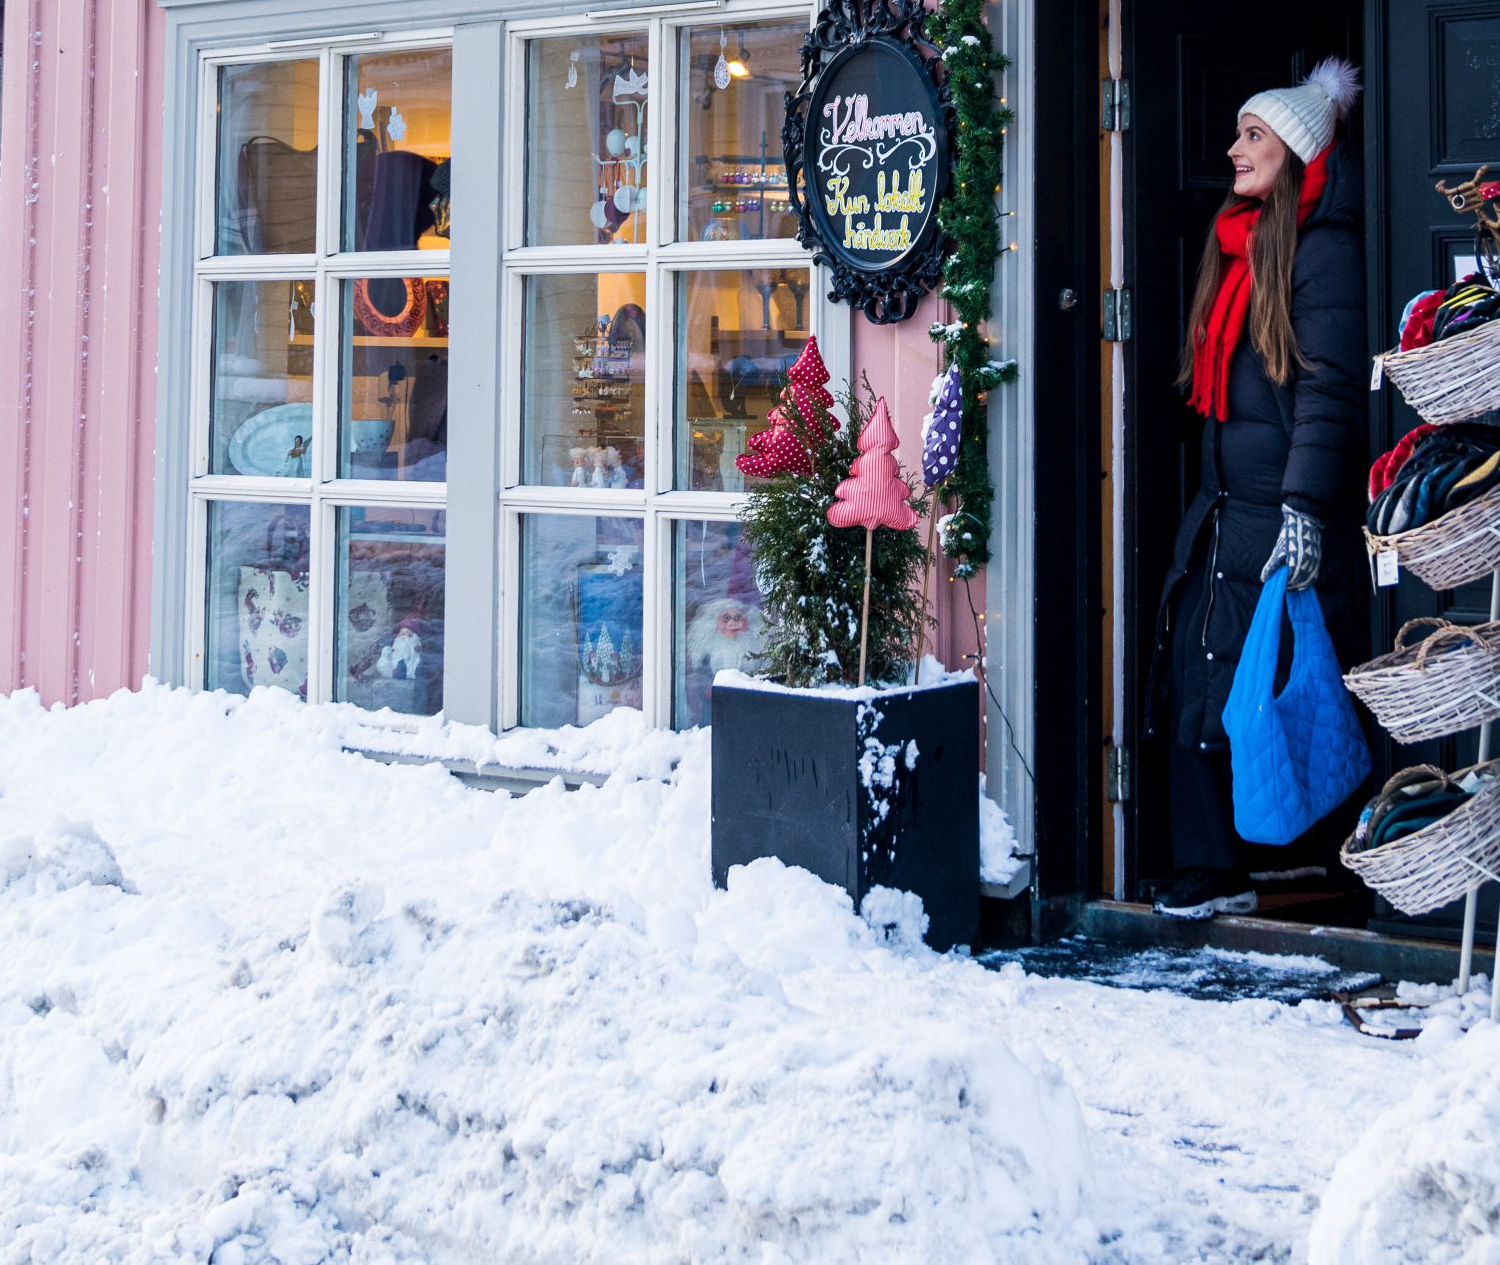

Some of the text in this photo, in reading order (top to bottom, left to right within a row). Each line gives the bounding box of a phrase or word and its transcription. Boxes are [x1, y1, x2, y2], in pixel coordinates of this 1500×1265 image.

[823, 93, 927, 145] Velkommen
[825, 169, 926, 215] Kun lokalt
[843, 212, 912, 251] håndverk
